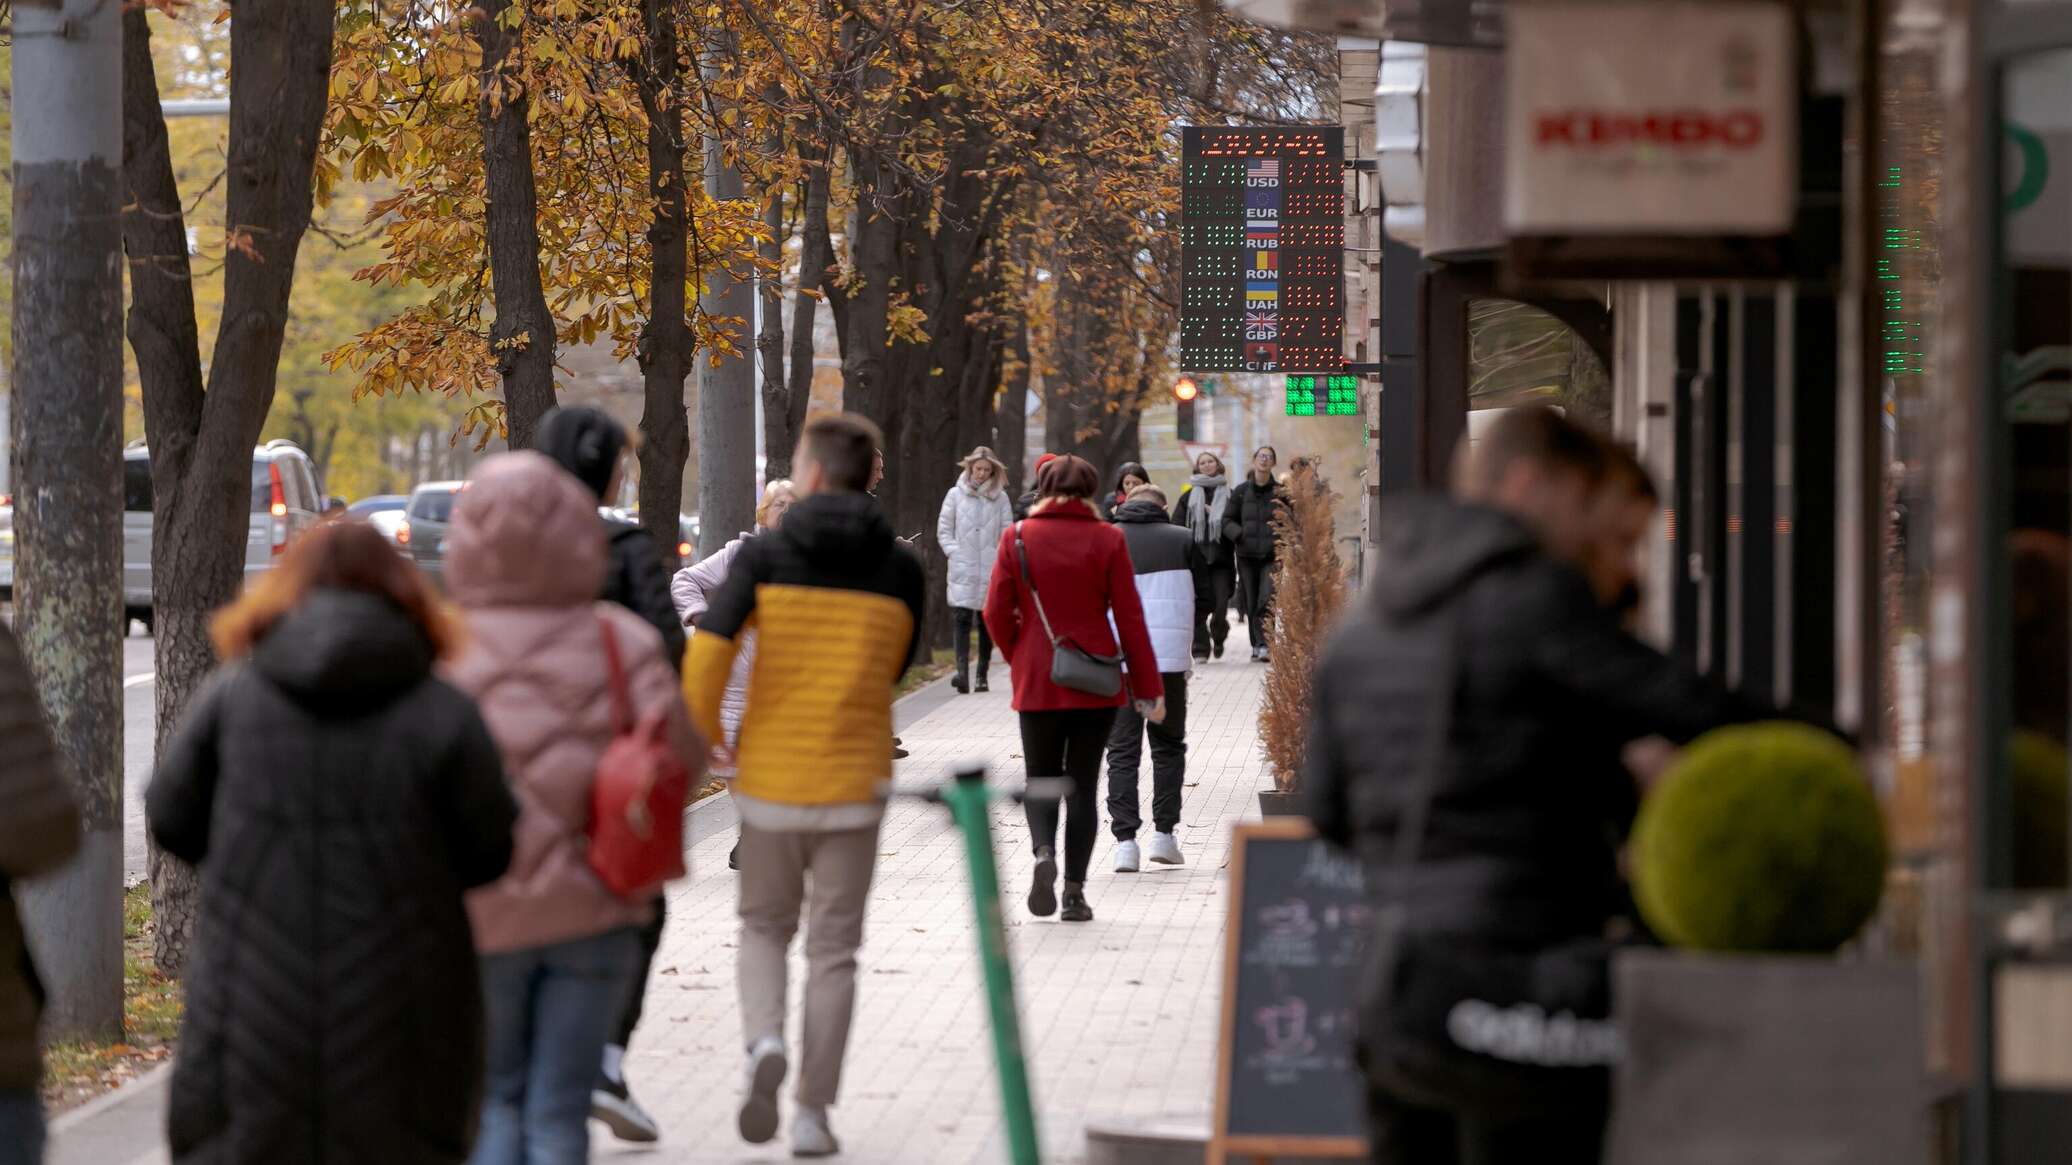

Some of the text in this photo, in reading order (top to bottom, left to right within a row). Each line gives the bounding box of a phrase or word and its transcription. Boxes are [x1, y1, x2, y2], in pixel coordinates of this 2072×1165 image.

[1534, 109, 1764, 150] KIMBO
[1247, 178, 1279, 188] USD
[1246, 208, 1278, 218] EUR
[1246, 239, 1279, 249] RUB
[1246, 270, 1278, 279] RON
[1246, 300, 1278, 310] UAH
[1245, 331, 1278, 340] GBP
